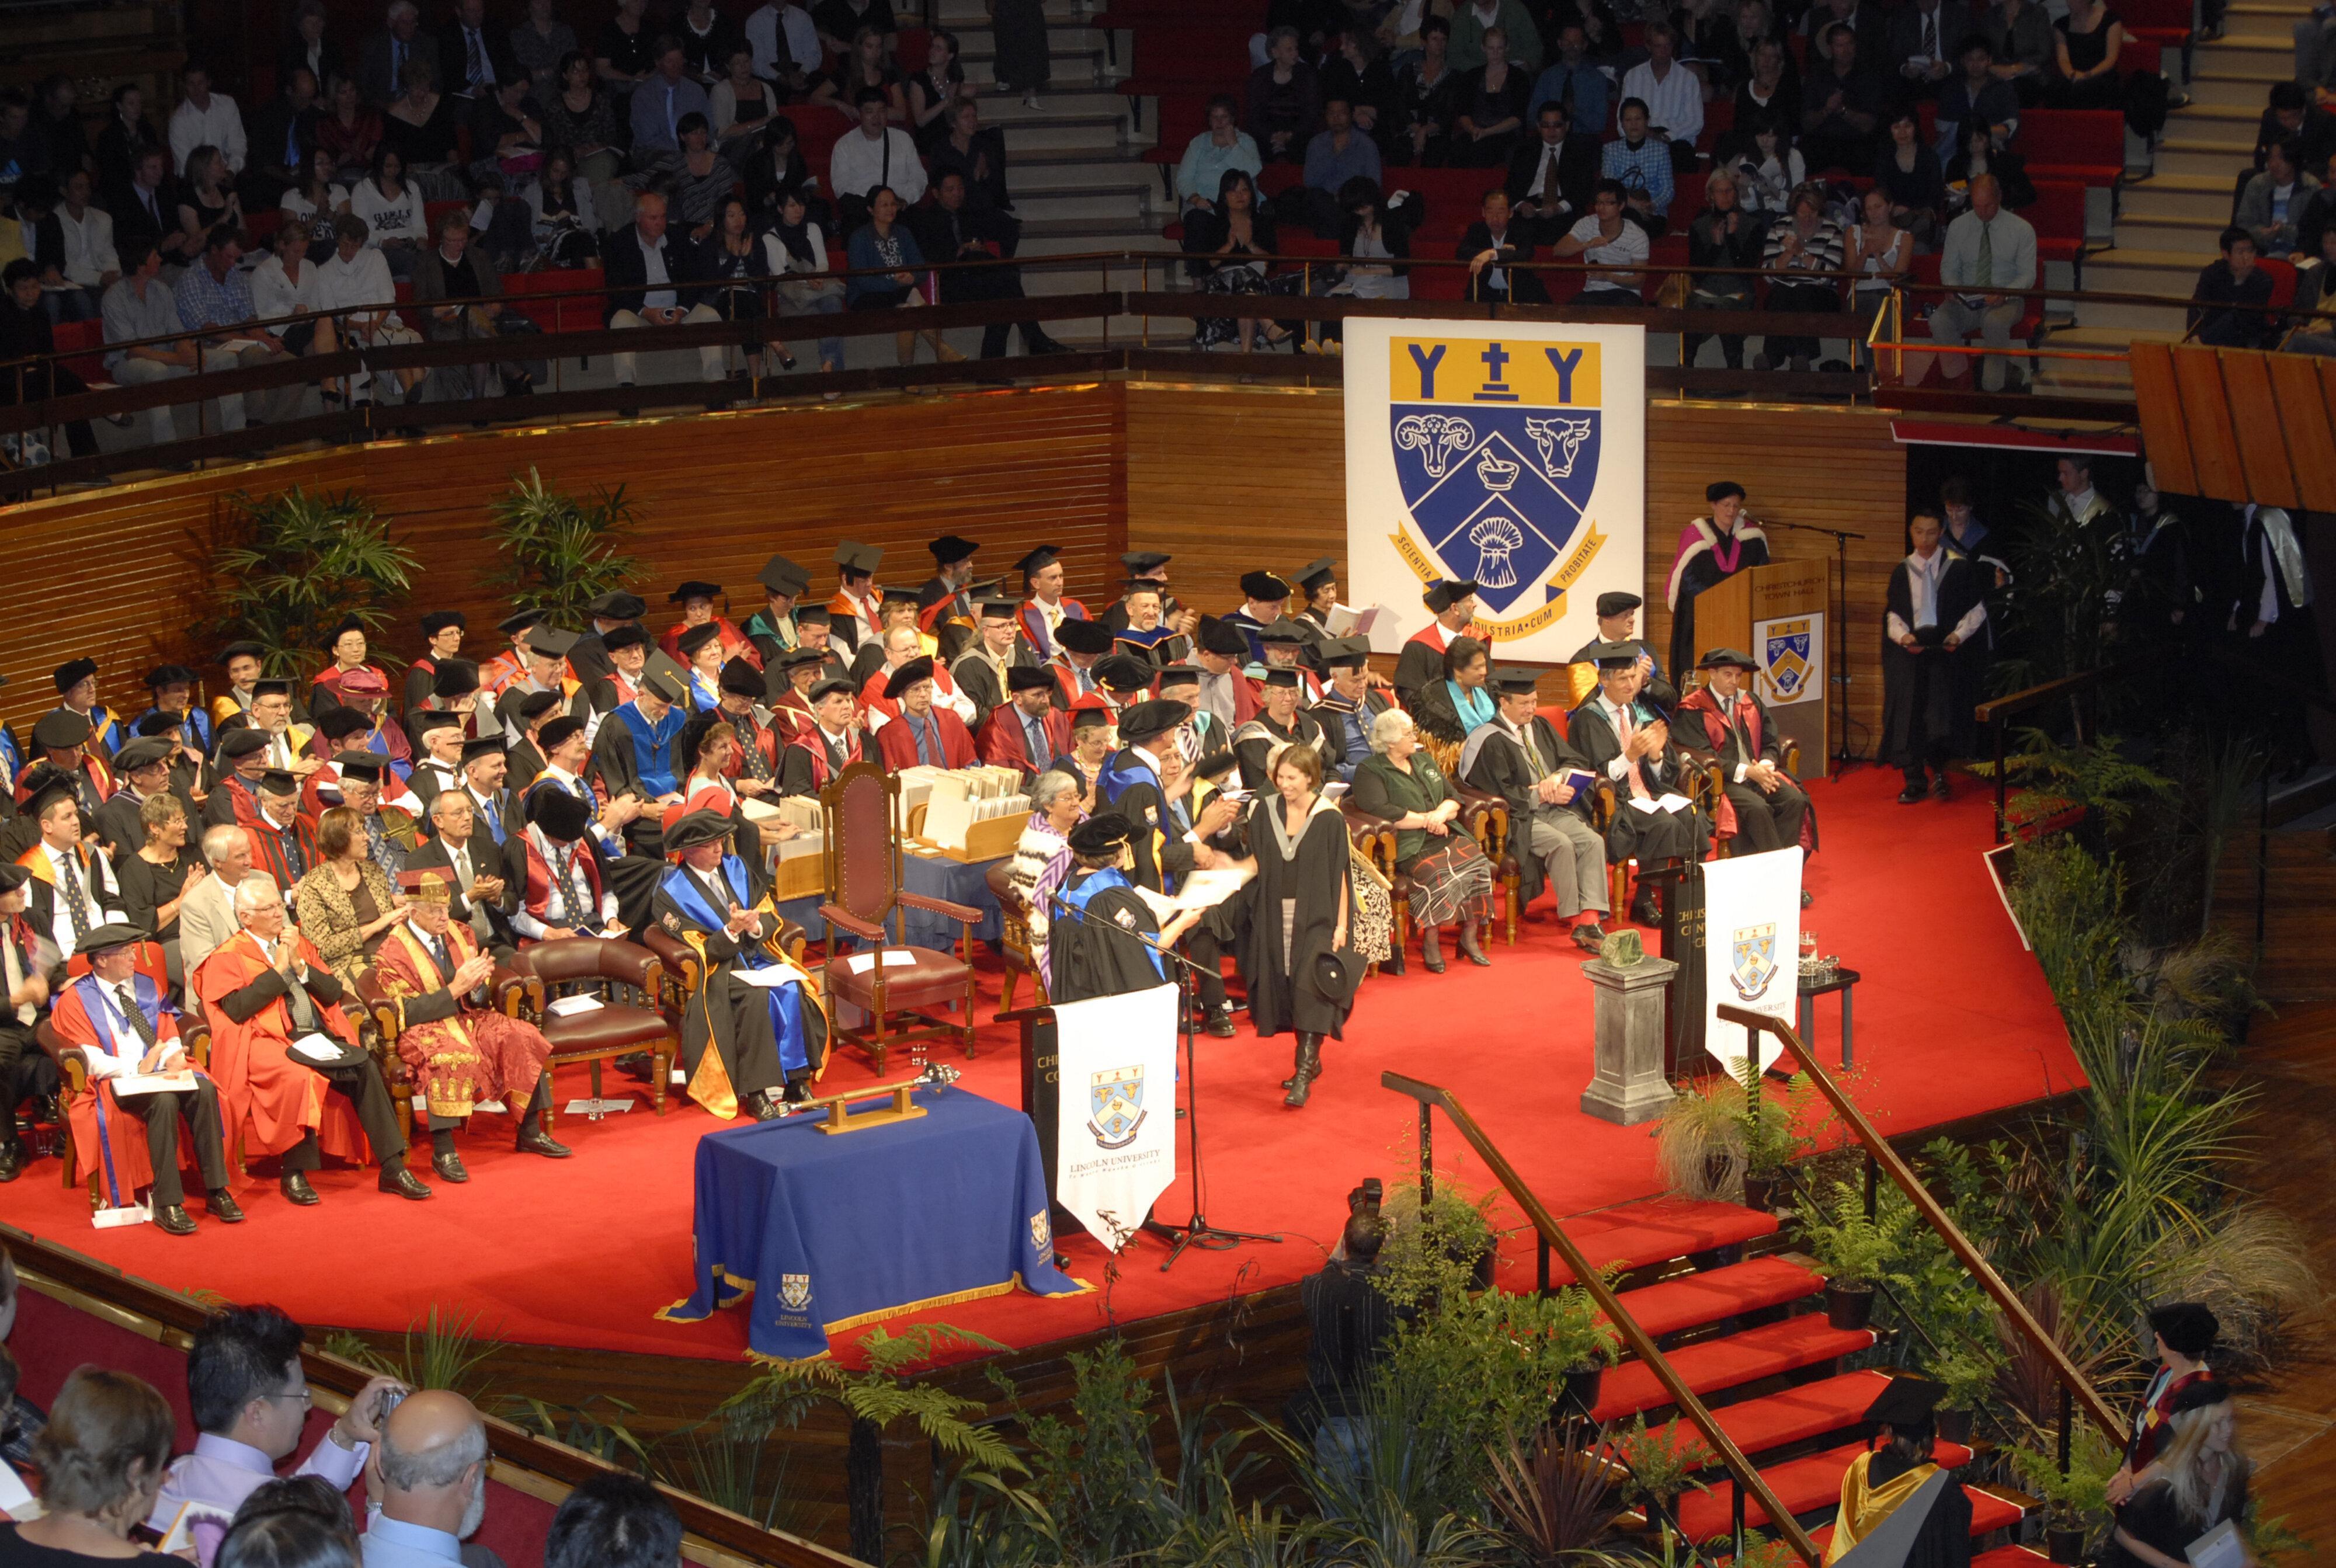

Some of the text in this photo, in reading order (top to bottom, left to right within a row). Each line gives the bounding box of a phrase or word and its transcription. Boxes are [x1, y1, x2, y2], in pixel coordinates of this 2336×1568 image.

[1398, 537, 1431, 579] SCIENTIA
[1560, 538, 1597, 582] PROBITATE
[1754, 576, 1824, 592] CHRISTCHURCH
[1764, 587, 1816, 600] TOWN HALL
[1475, 608, 1552, 637] DUSTRIA CUM
[1070, 1159, 1108, 1173] LINCOLN
[1111, 1149, 1160, 1165] UNIVERSITY
[775, 1320, 812, 1329] UNIVERSITY
